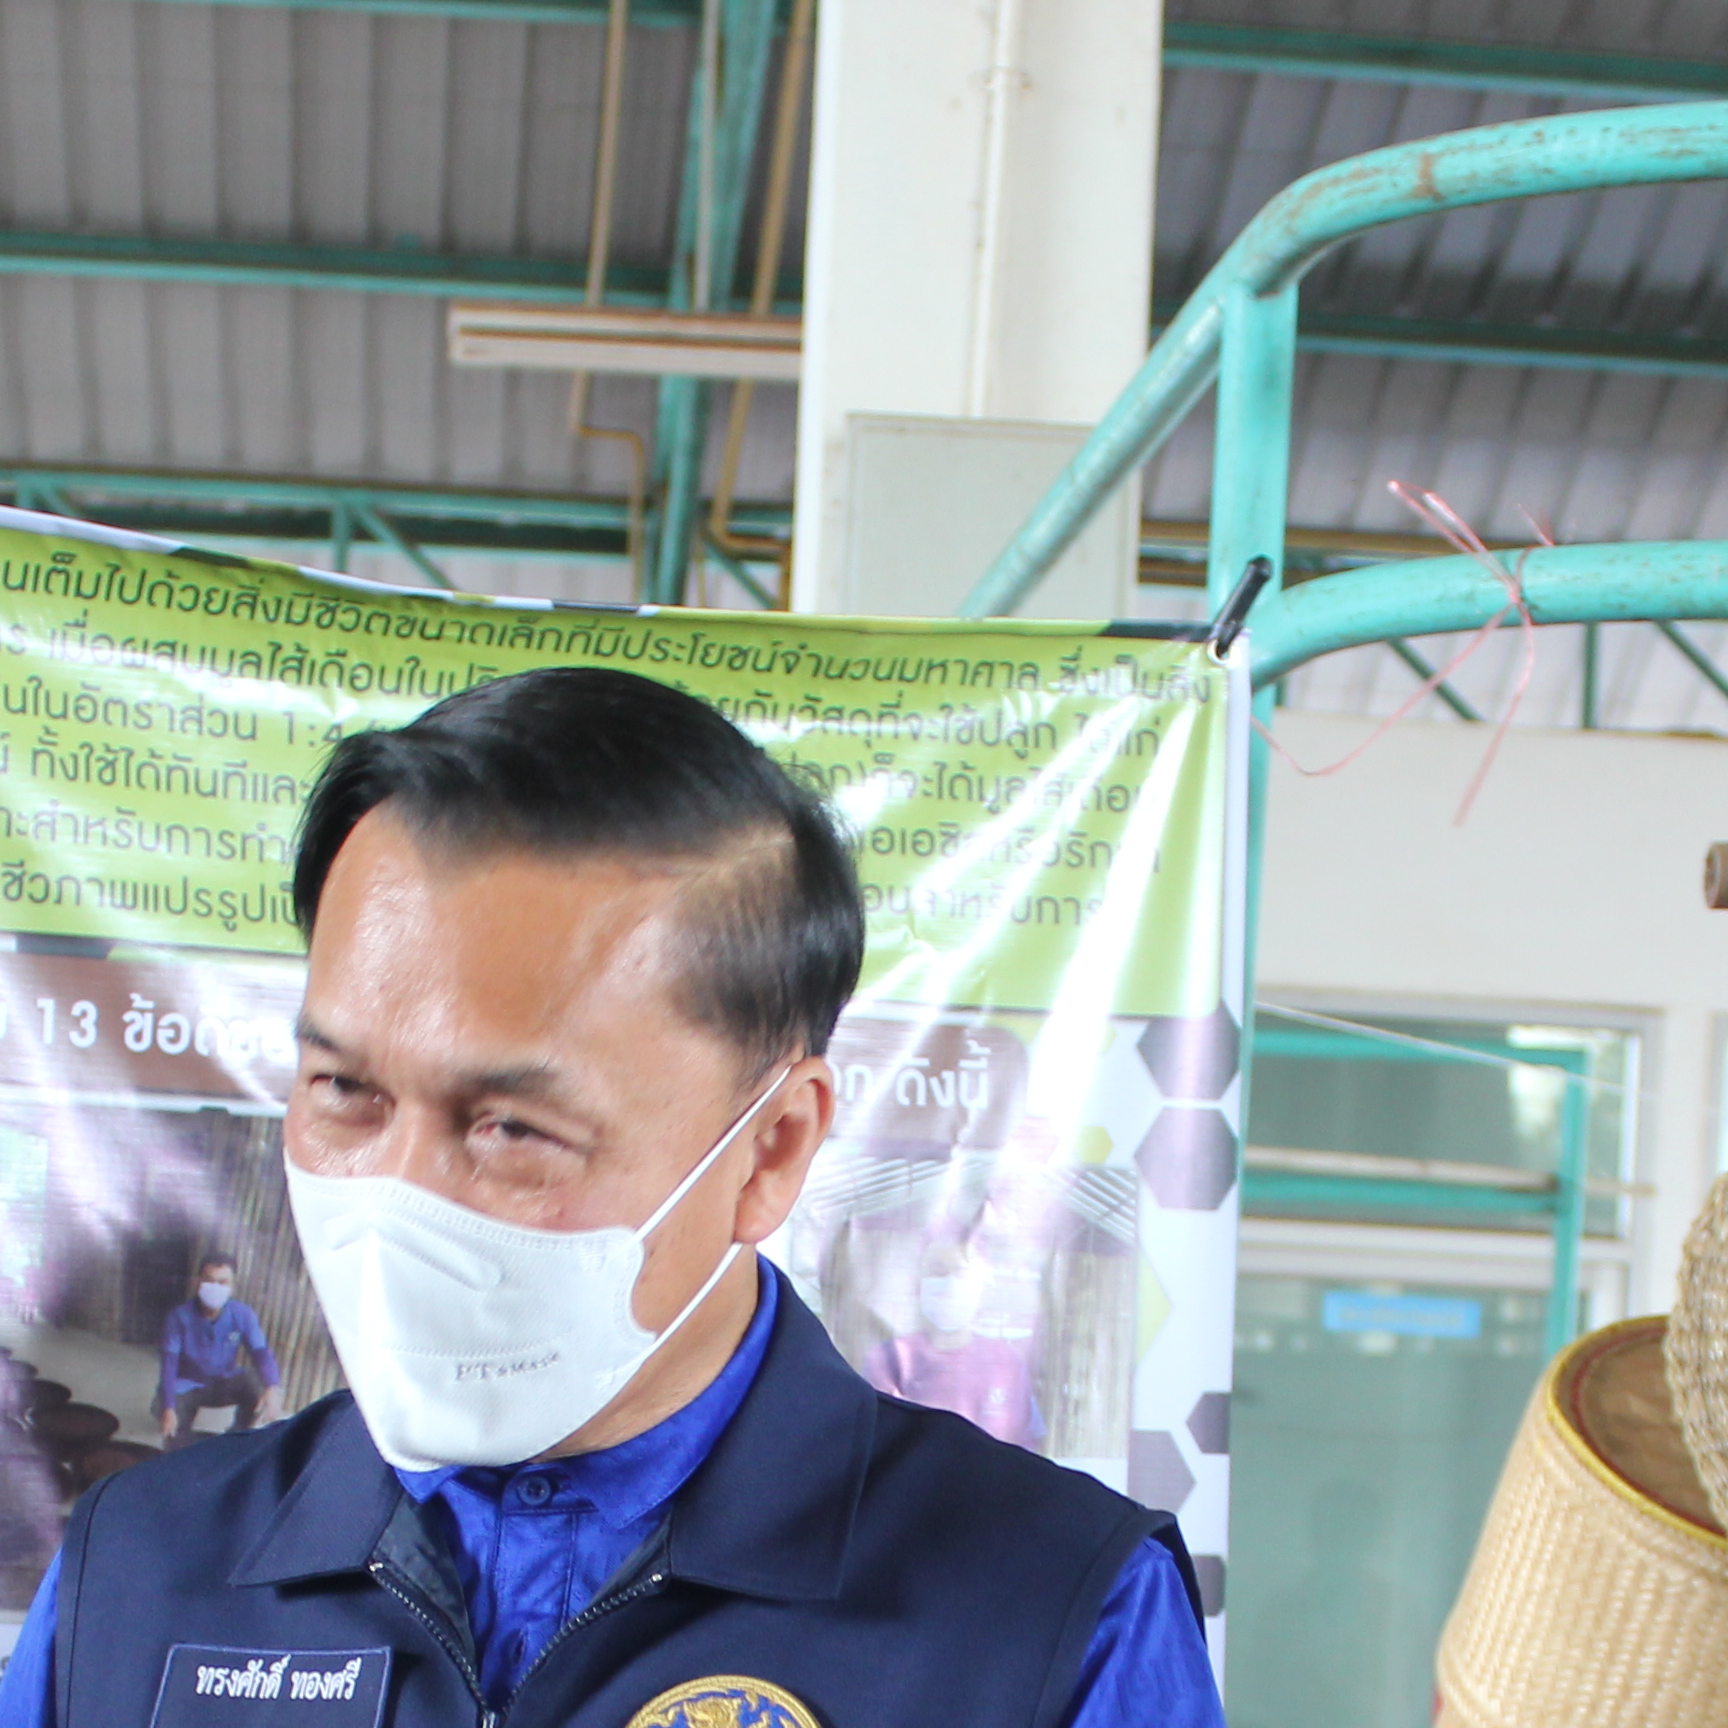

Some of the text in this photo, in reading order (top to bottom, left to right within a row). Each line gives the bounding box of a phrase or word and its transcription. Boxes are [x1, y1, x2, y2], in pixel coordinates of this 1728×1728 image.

[36, 997, 99, 1049] 13
[896, 1040, 991, 1109] ดังนี้
[195, 1653, 363, 1701] ทรงศักดิ์ ทองศรี
